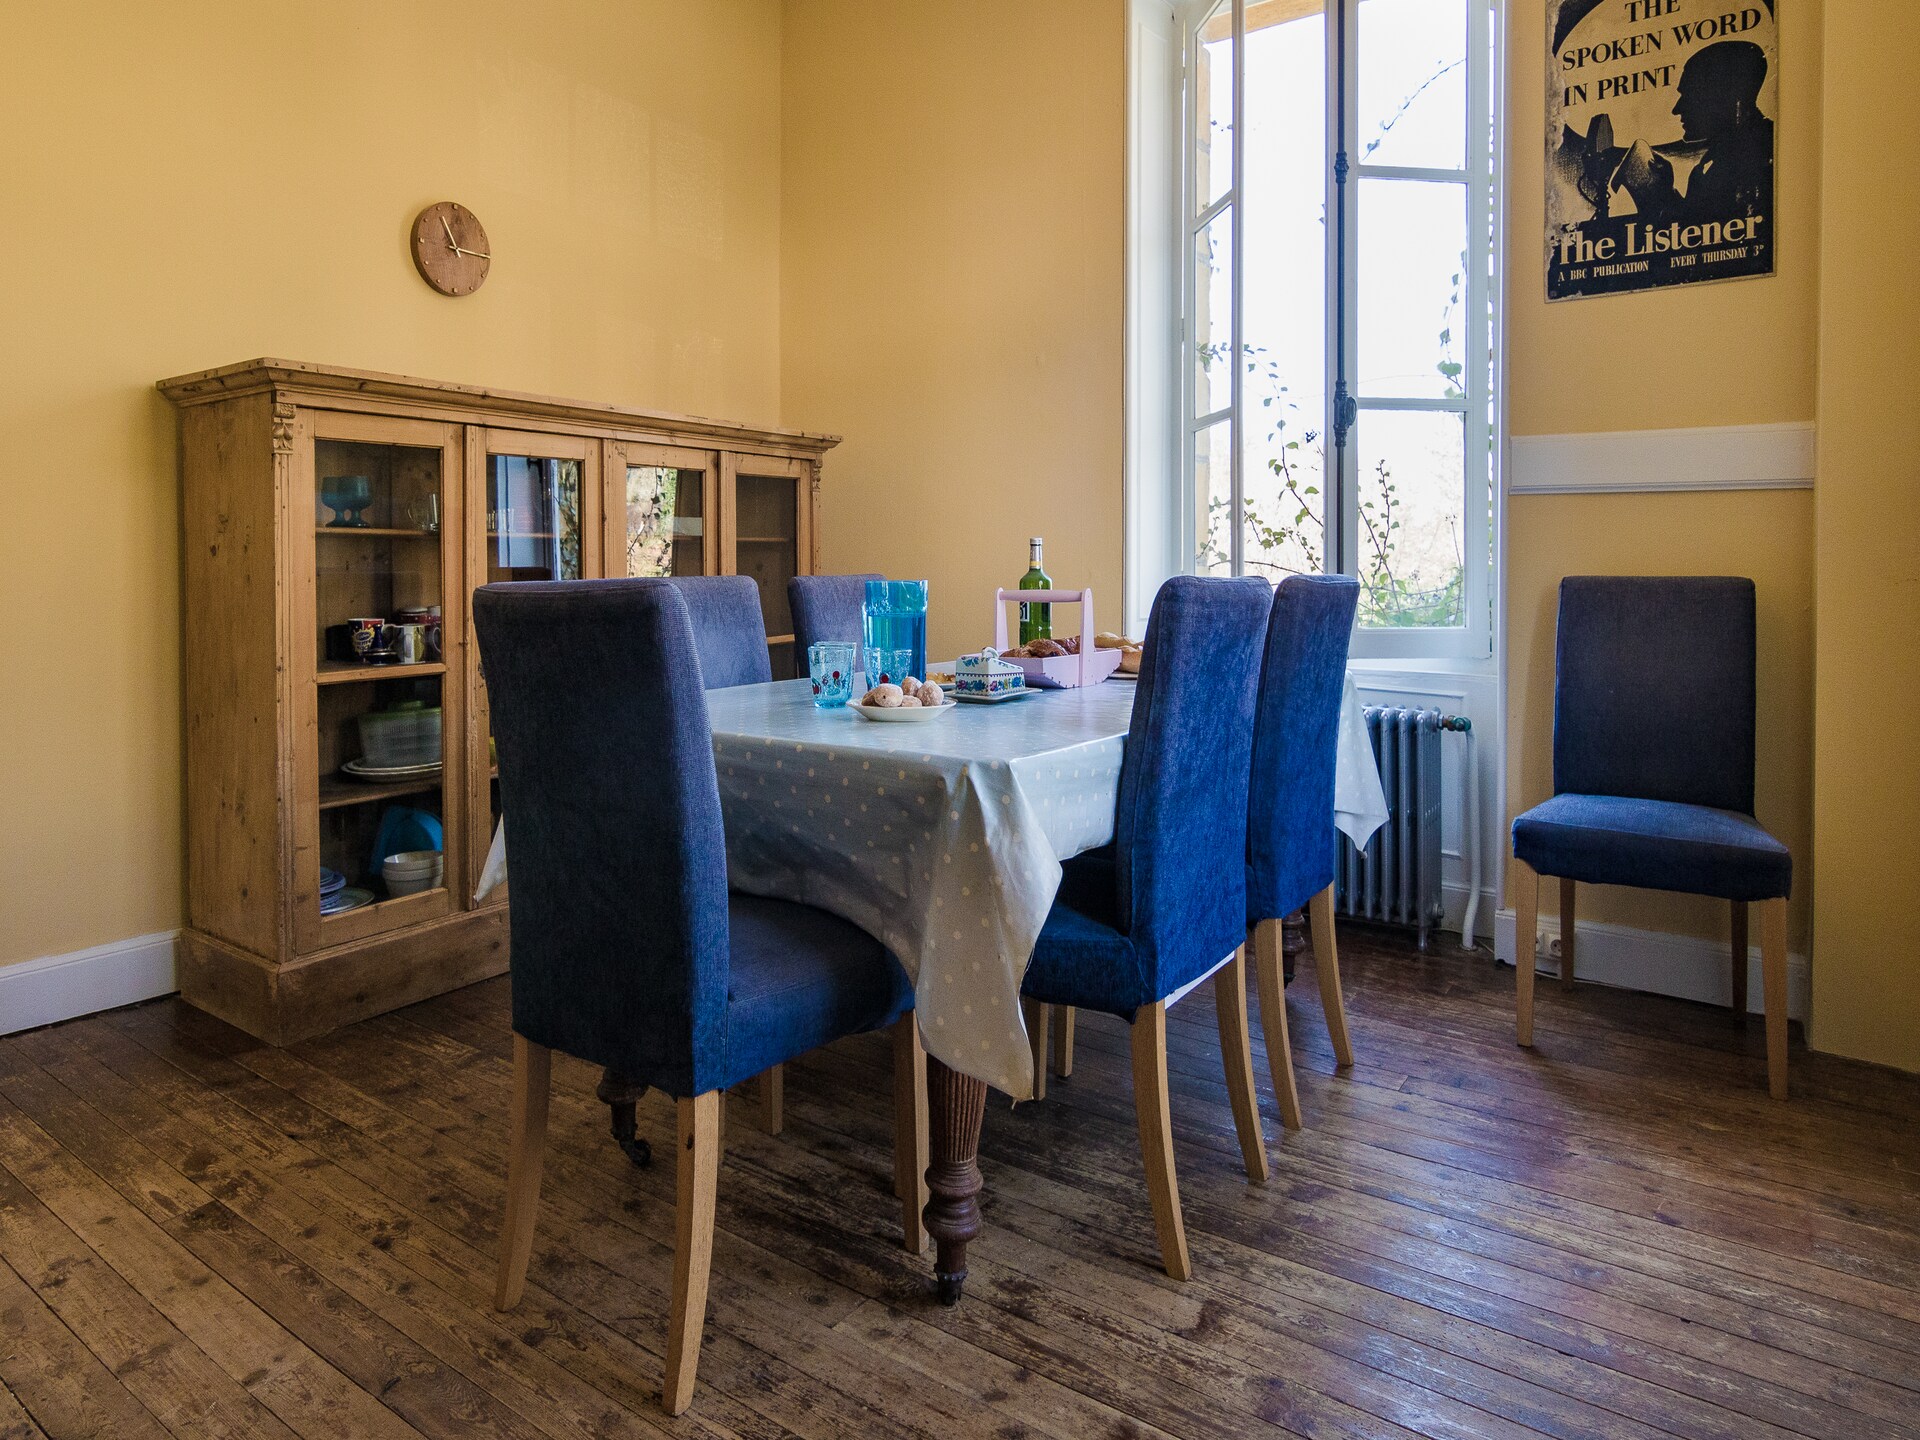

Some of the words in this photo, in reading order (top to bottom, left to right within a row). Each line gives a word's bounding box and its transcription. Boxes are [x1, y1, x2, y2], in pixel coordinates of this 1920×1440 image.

[1625, 0, 1681, 23] THE
[1562, 30, 1663, 71] SPOKEN
[1671, 8, 1761, 46] WORD
[1563, 83, 1588, 107] IN
[1597, 65, 1676, 101] PRINT
[1624, 215, 1763, 257] Listener
[1558, 271, 1565, 282] A
[1570, 269, 1587, 280] BBC
[1593, 260, 1649, 278] PUBLICATION
[1670, 254, 1697, 268] EVERY
[1702, 246, 1748, 264] THURSDAY
